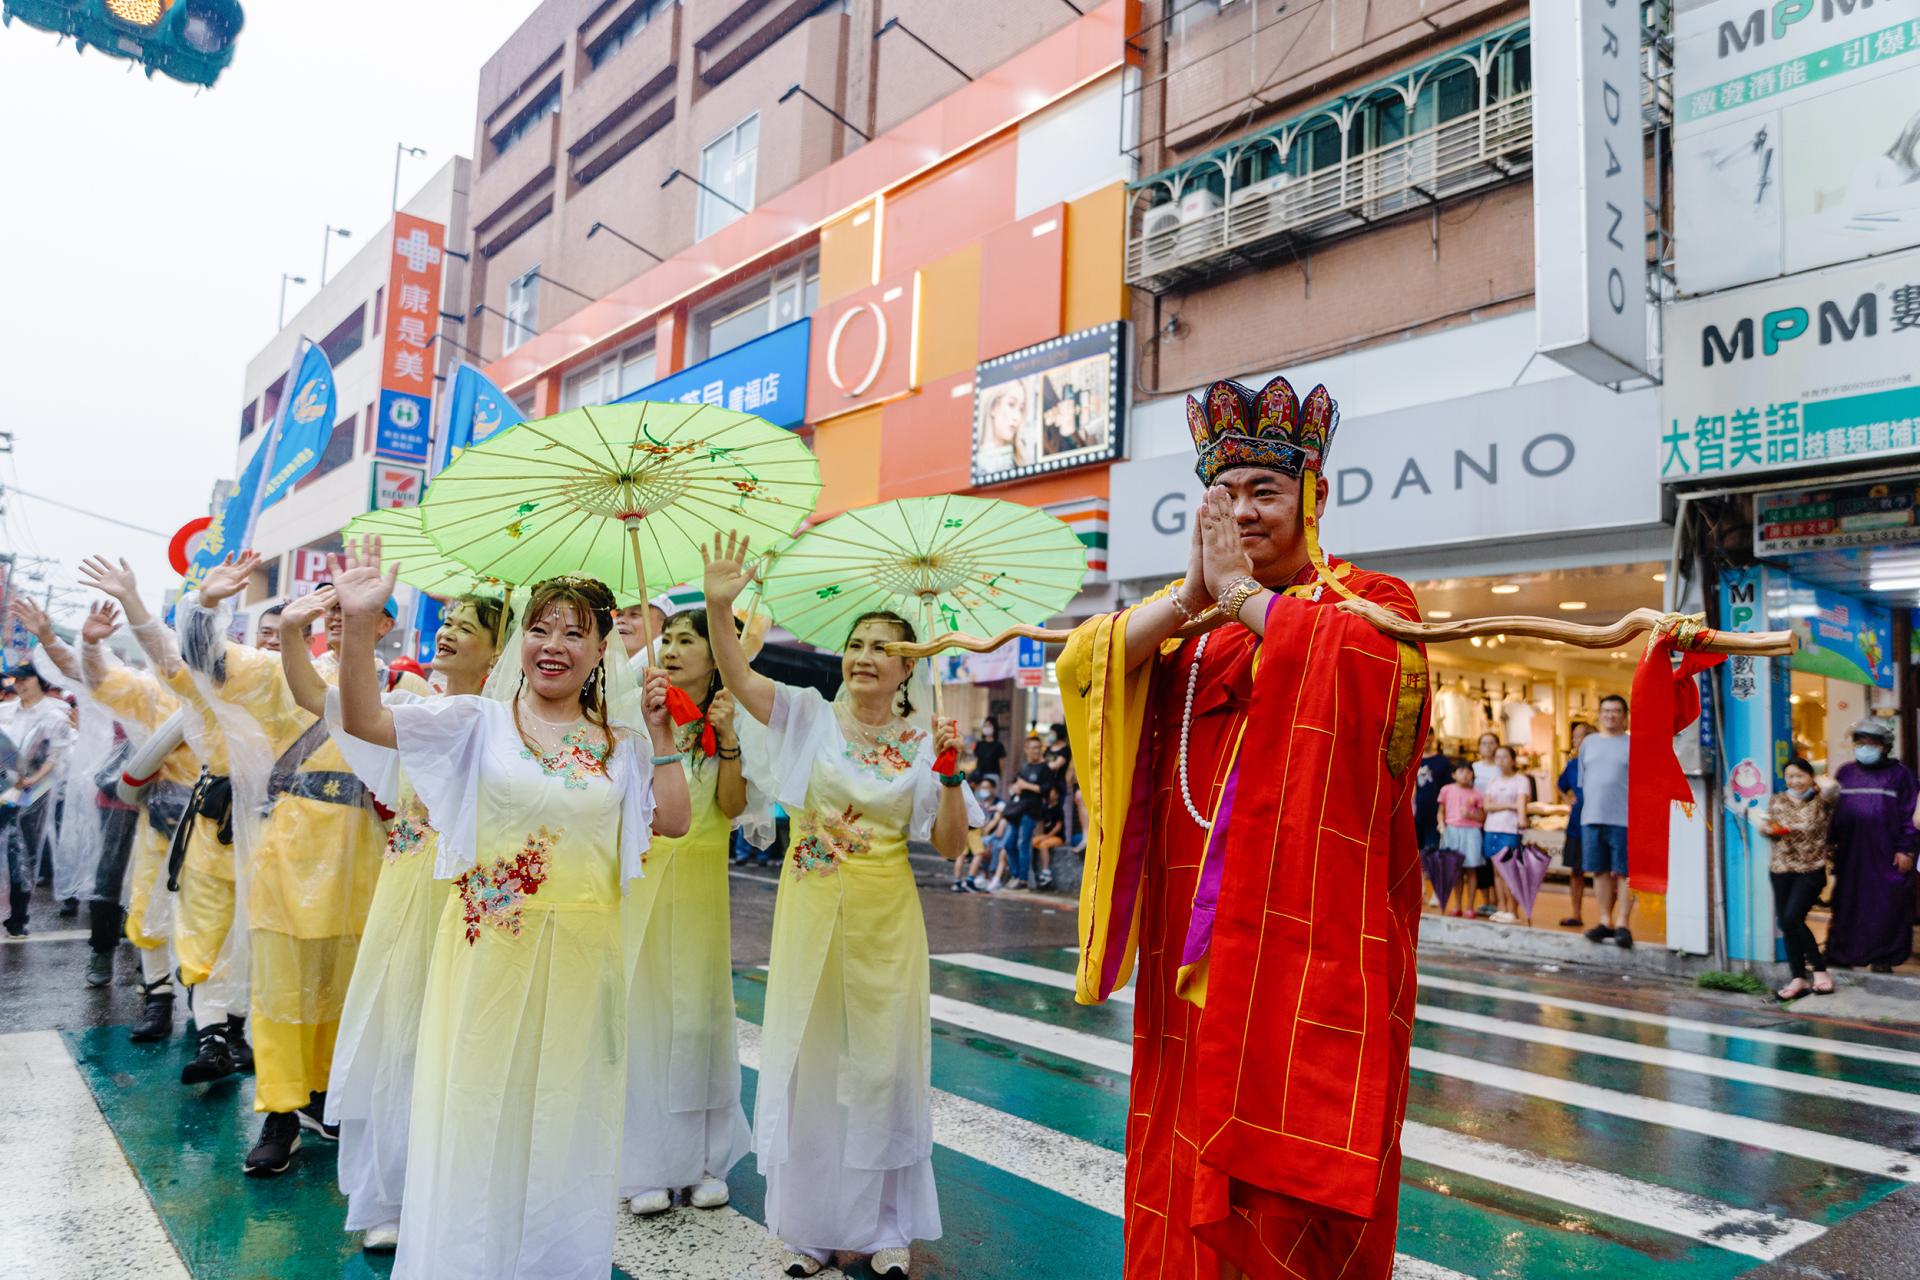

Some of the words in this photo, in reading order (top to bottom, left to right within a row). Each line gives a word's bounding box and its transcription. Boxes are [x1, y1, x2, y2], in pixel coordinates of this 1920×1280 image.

[393, 284, 430, 382] 康是美
[1702, 292, 1877, 367] MPM
[1662, 402, 1799, 476] 大智美語
[1151, 433, 1577, 537] GDANO
